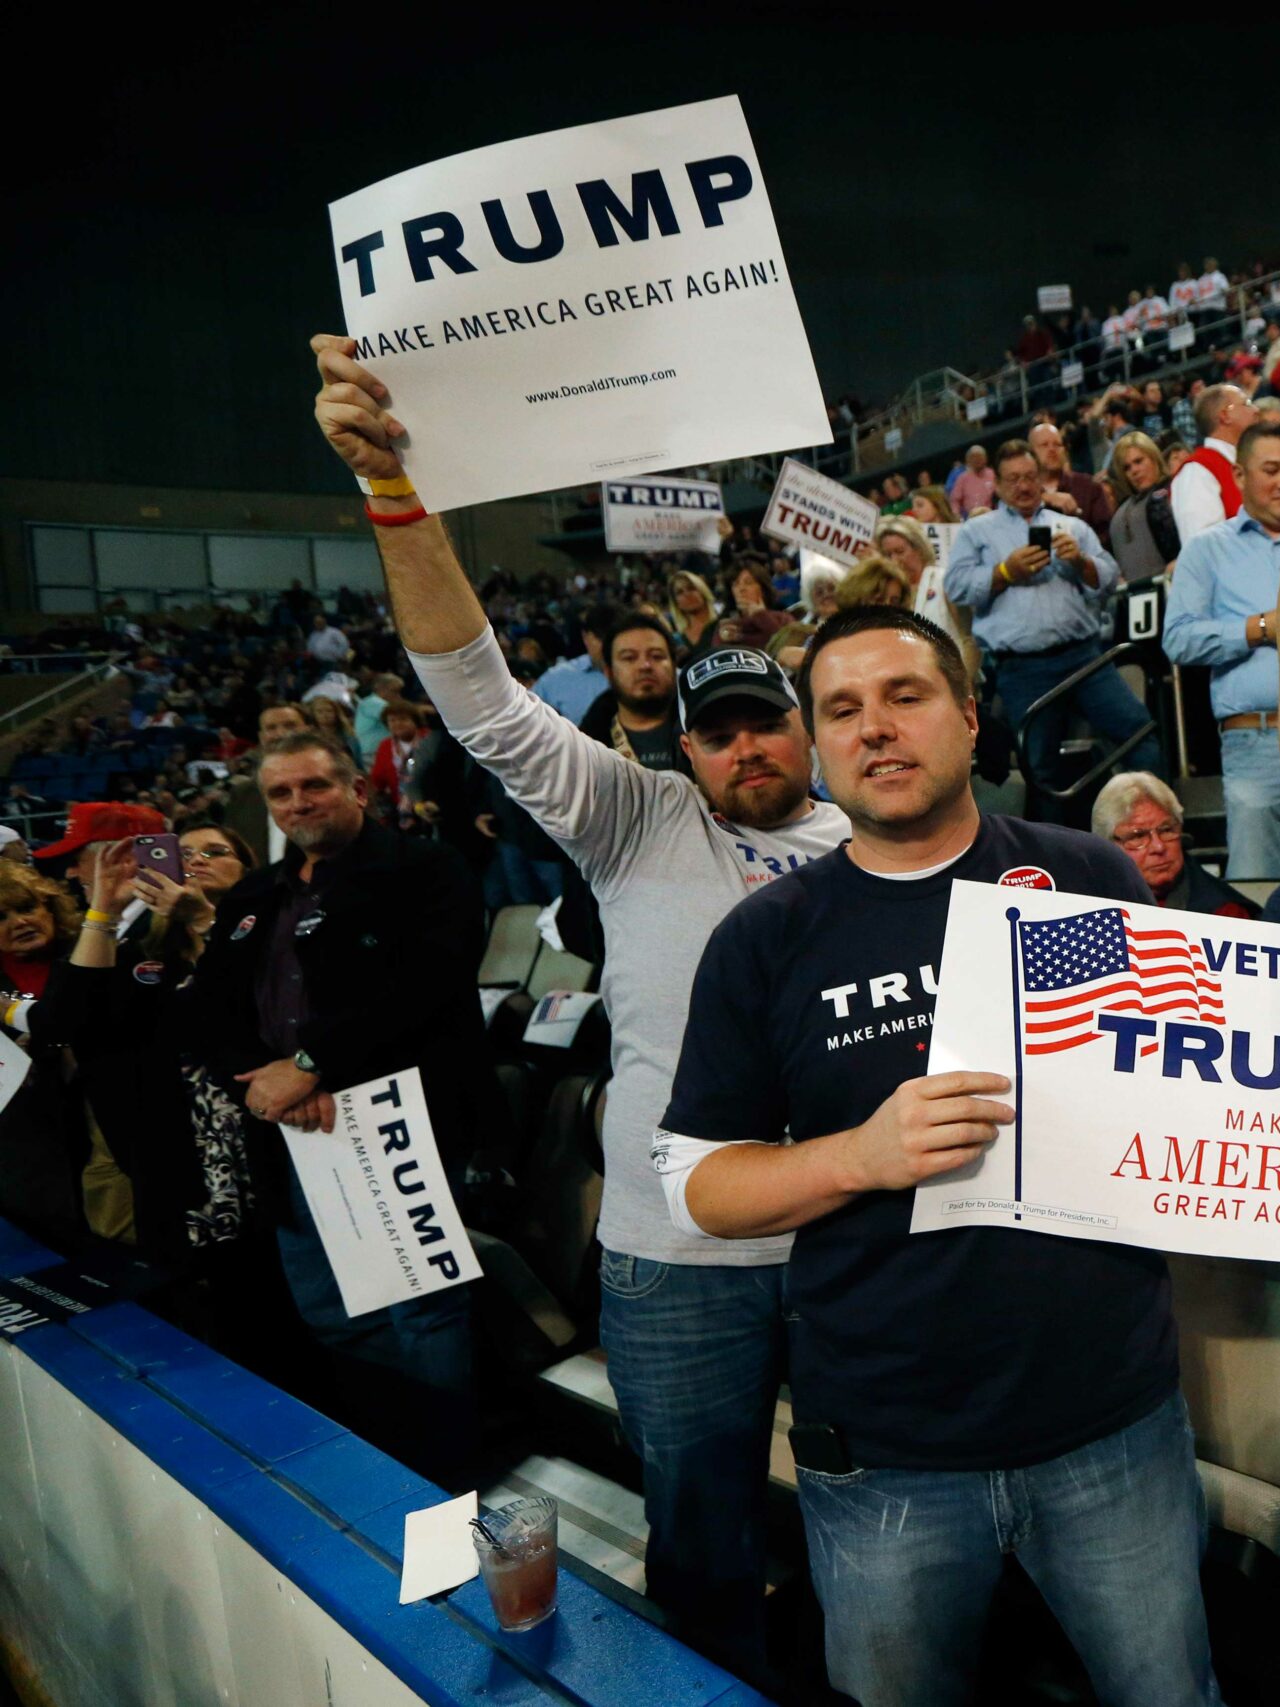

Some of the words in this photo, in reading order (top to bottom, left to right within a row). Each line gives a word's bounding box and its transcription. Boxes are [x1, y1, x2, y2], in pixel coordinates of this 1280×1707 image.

[341, 154, 754, 298] TRUMP
[352, 324, 436, 362] MAKE
[442, 298, 578, 345] AMERICA
[584, 278, 676, 317] GREAT
[685, 258, 780, 300] AGAIN!
[525, 367, 677, 404] www.DonaldJTrump.com
[609, 485, 719, 509] TRUMP
[782, 488, 835, 520] STANDS
[840, 515, 871, 538] WITH
[1134, 600, 1152, 634] J
[1004, 872, 1042, 885] TRUMP
[821, 964, 939, 1019] TRU
[826, 1026, 875, 1051] MAKE
[880, 1012, 934, 1036] AMERI
[340, 1092, 359, 1133] MAKE
[350, 1136, 381, 1199] AMERICA
[376, 1201, 401, 1242] GREAT
[394, 1246, 423, 1293] AGAIN!
[371, 1079, 460, 1281] TRUMP
[948, 1200, 964, 1210] Paid
[965, 1200, 976, 1208] for
[977, 1200, 986, 1209] by
[987, 1200, 1015, 1211] Donald
[1023, 1204, 1047, 1217] Trump
[1047, 1208, 1058, 1217] for
[1153, 1192, 1246, 1221] GREAT
